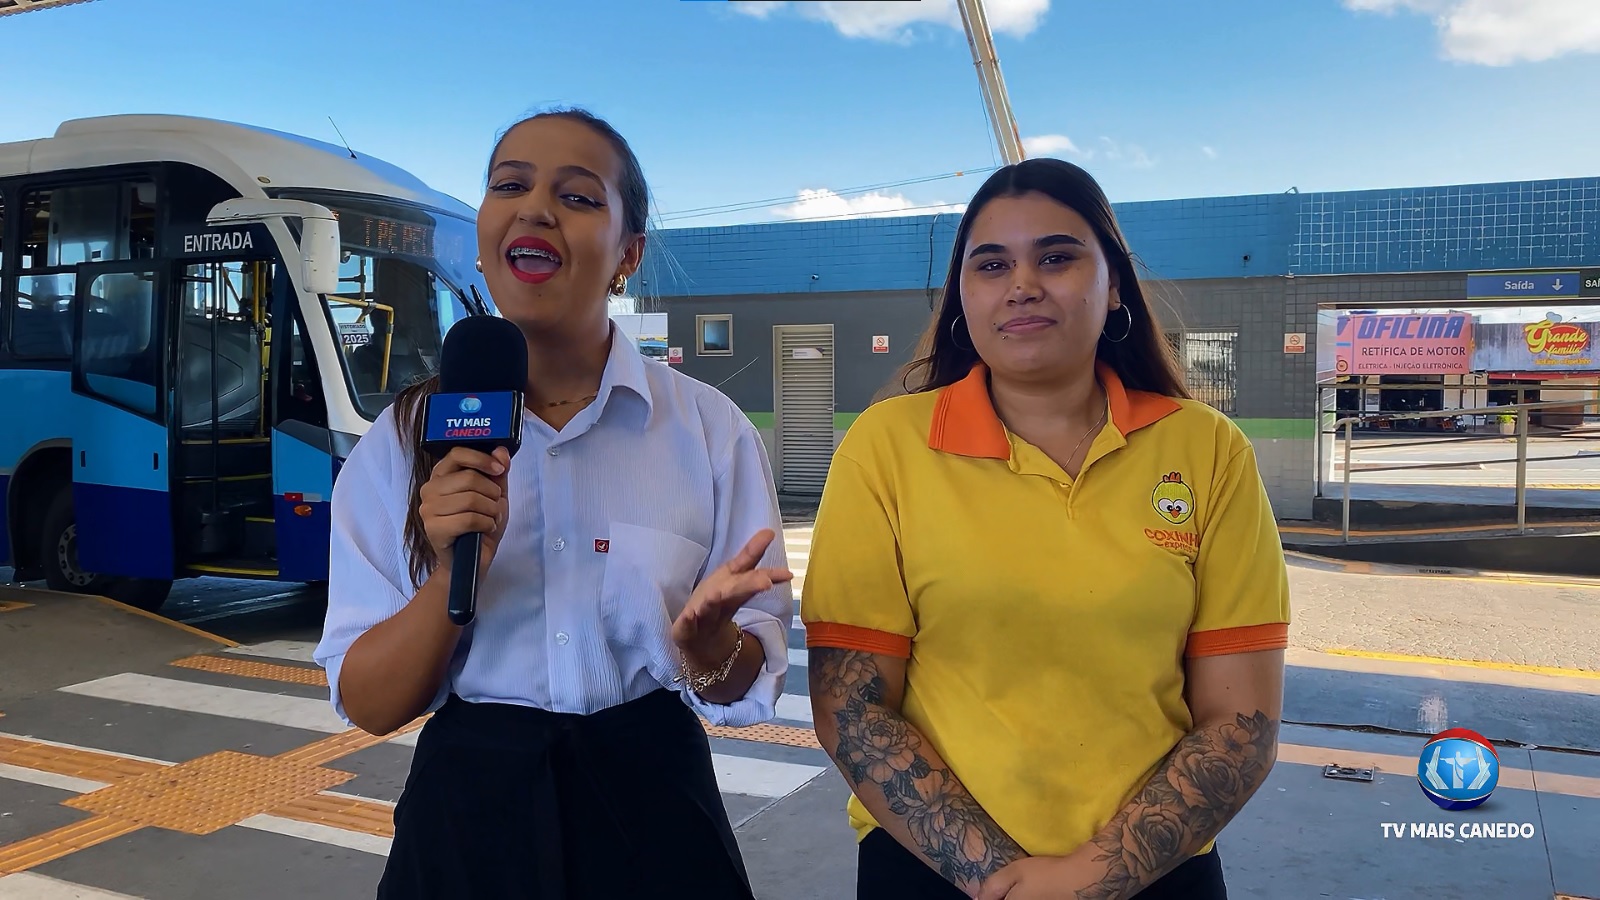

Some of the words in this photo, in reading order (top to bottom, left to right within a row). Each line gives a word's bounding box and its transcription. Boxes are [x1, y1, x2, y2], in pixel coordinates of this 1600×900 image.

[184, 231, 253, 253] ENTRADA
[1504, 281, 1535, 290] Saída
[1357, 316, 1465, 339] OFICINA
[343, 334, 369, 344] 2025
[1524, 319, 1588, 353] Grande
[1361, 344, 1407, 356] RETÍFICA
[1410, 347, 1423, 356] DE
[1426, 346, 1466, 356] MOTOR
[446, 418, 462, 428] TV
[463, 418, 491, 427] MAIS
[445, 428, 491, 438] CANEDO
[1144, 528, 1199, 548] COXINH
